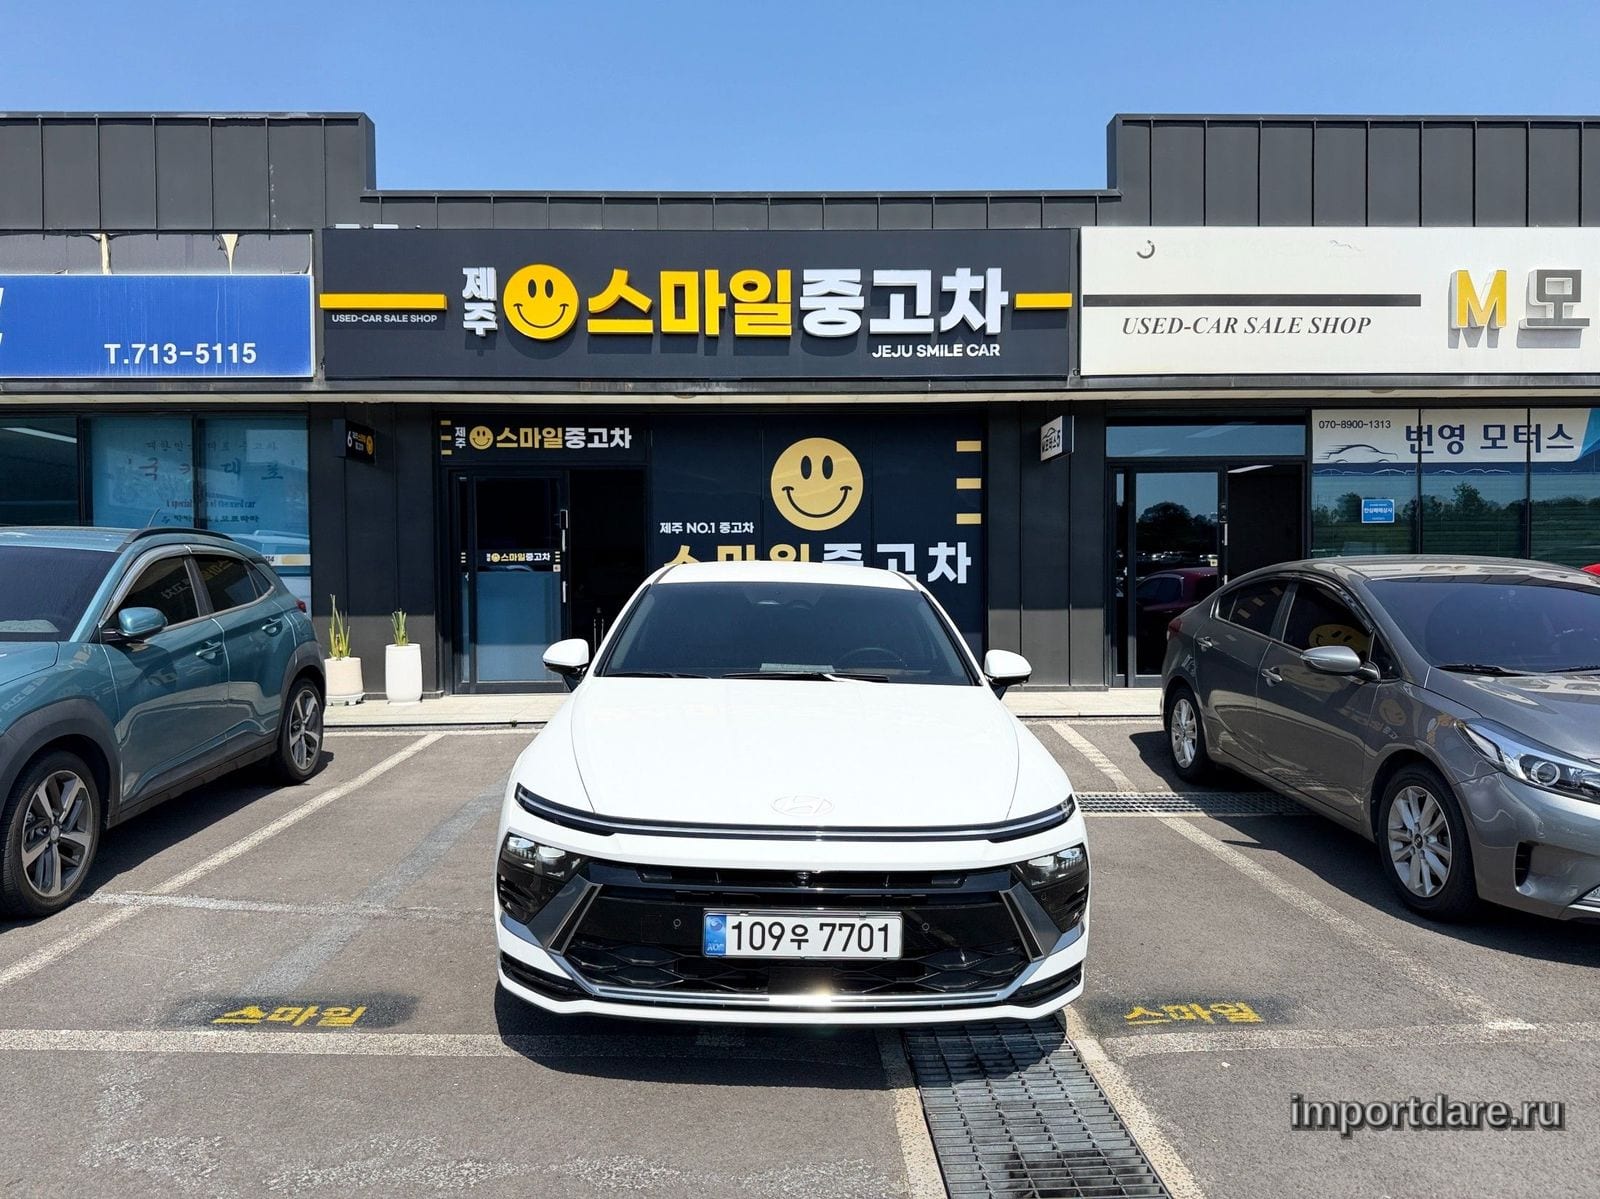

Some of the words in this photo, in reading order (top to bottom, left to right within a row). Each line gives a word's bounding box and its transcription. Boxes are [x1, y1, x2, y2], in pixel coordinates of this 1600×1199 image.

[461, 266, 498, 338] 제주
[587, 267, 1010, 339] 스마일중고차
[1450, 269, 1507, 330] M
[1526, 269, 1591, 328] 모
[331, 314, 382, 324] USED-CAR
[384, 314, 409, 324] SALE
[410, 314, 438, 324] SHOP
[1122, 316, 1237, 335] USED-CAR
[1243, 316, 1303, 335] SALE
[1307, 316, 1372, 335] SHOP
[104, 343, 257, 365] T.713-5115
[872, 344, 914, 359] JEJU
[916, 344, 963, 359] SMILE
[965, 344, 1001, 359] CAR
[1318, 419, 1392, 430] 070-8900-1313
[495, 426, 632, 450] 스마일중고차
[1405, 423, 1466, 456] 번영
[1480, 423, 1575, 454] 모터스
[659, 521, 684, 534] 제주
[686, 522, 716, 534] NO.1
[718, 521, 755, 534] 중고차
[500, 552, 551, 562] 스마일중고차
[731, 920, 810, 952] 109우
[819, 922, 890, 953] 7701
[212, 1004, 368, 1028] 스마일
[1124, 1001, 1264, 1026] 스마일
